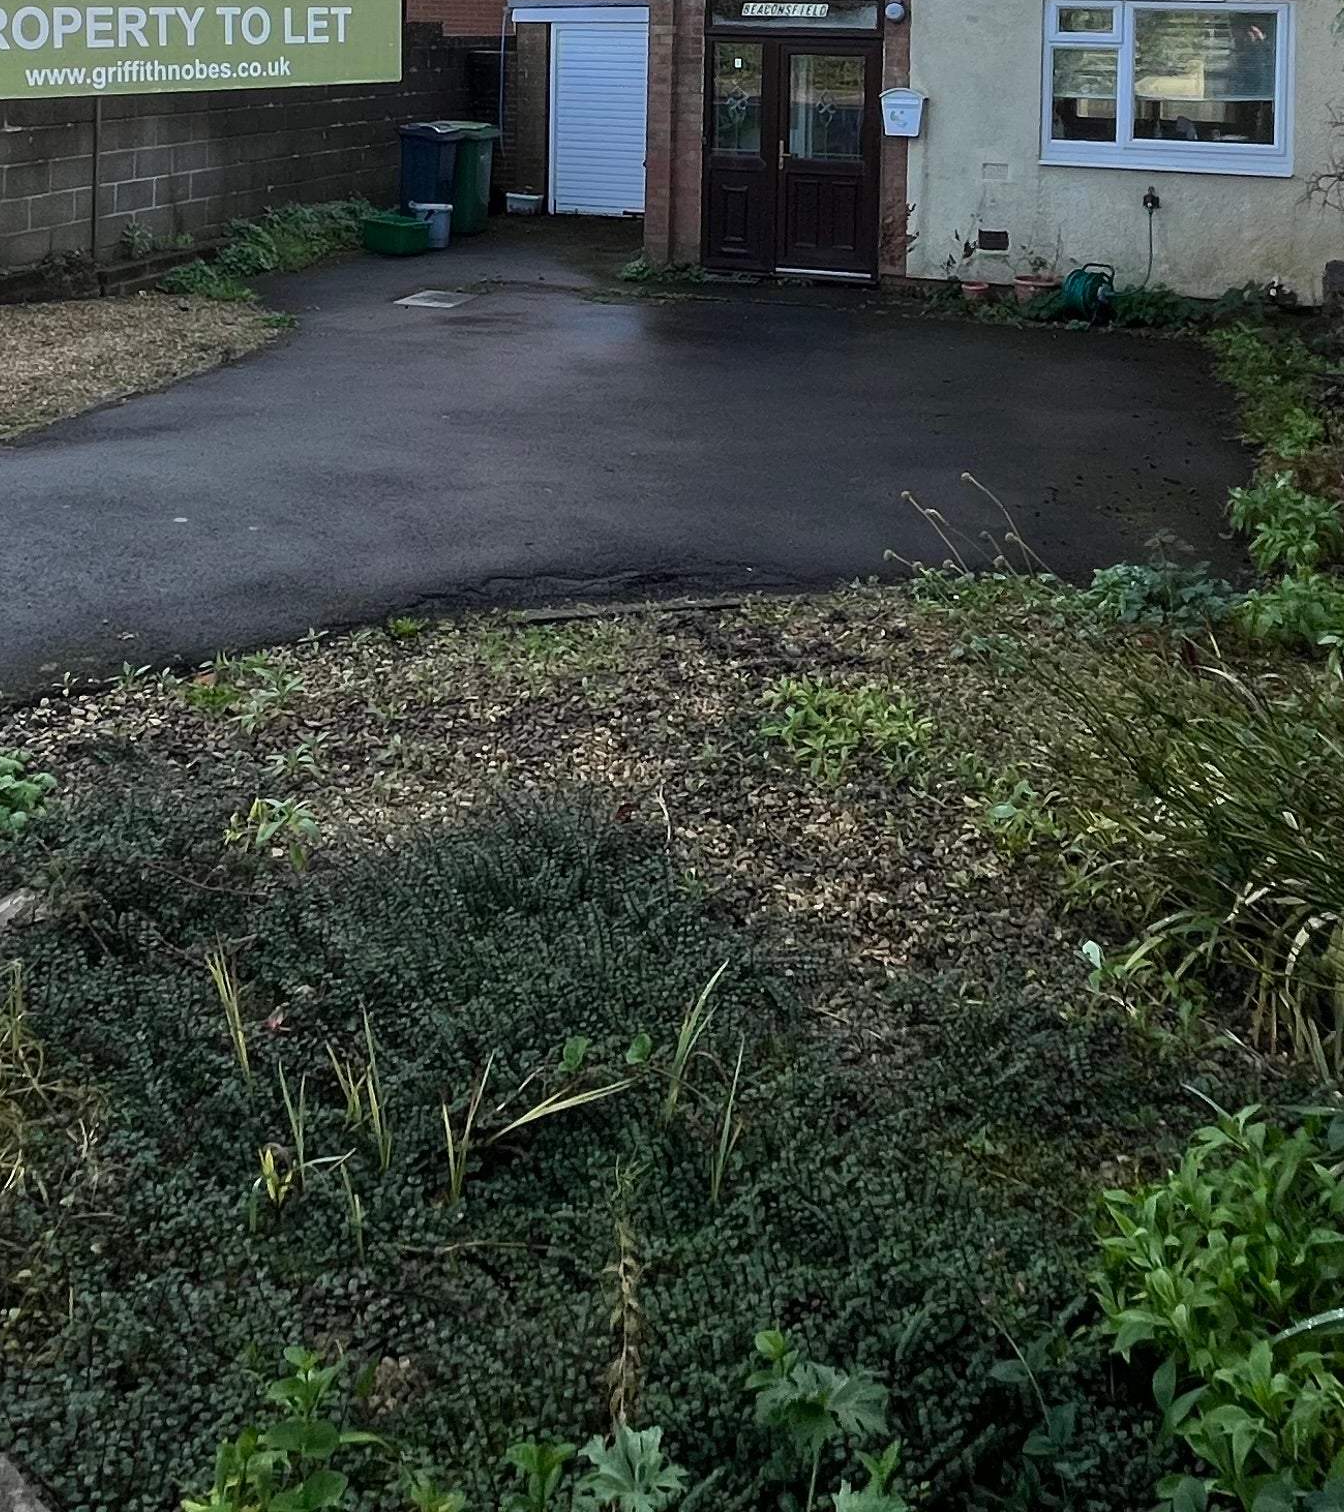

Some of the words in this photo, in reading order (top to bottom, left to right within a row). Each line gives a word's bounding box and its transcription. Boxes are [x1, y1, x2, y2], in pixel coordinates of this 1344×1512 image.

[216, 6, 271, 46] TO
[284, 6, 353, 44] LET
[743, 4, 827, 16] BEACONSFIELD
[25, 56, 291, 90] www.griffithnobes.co.uk
